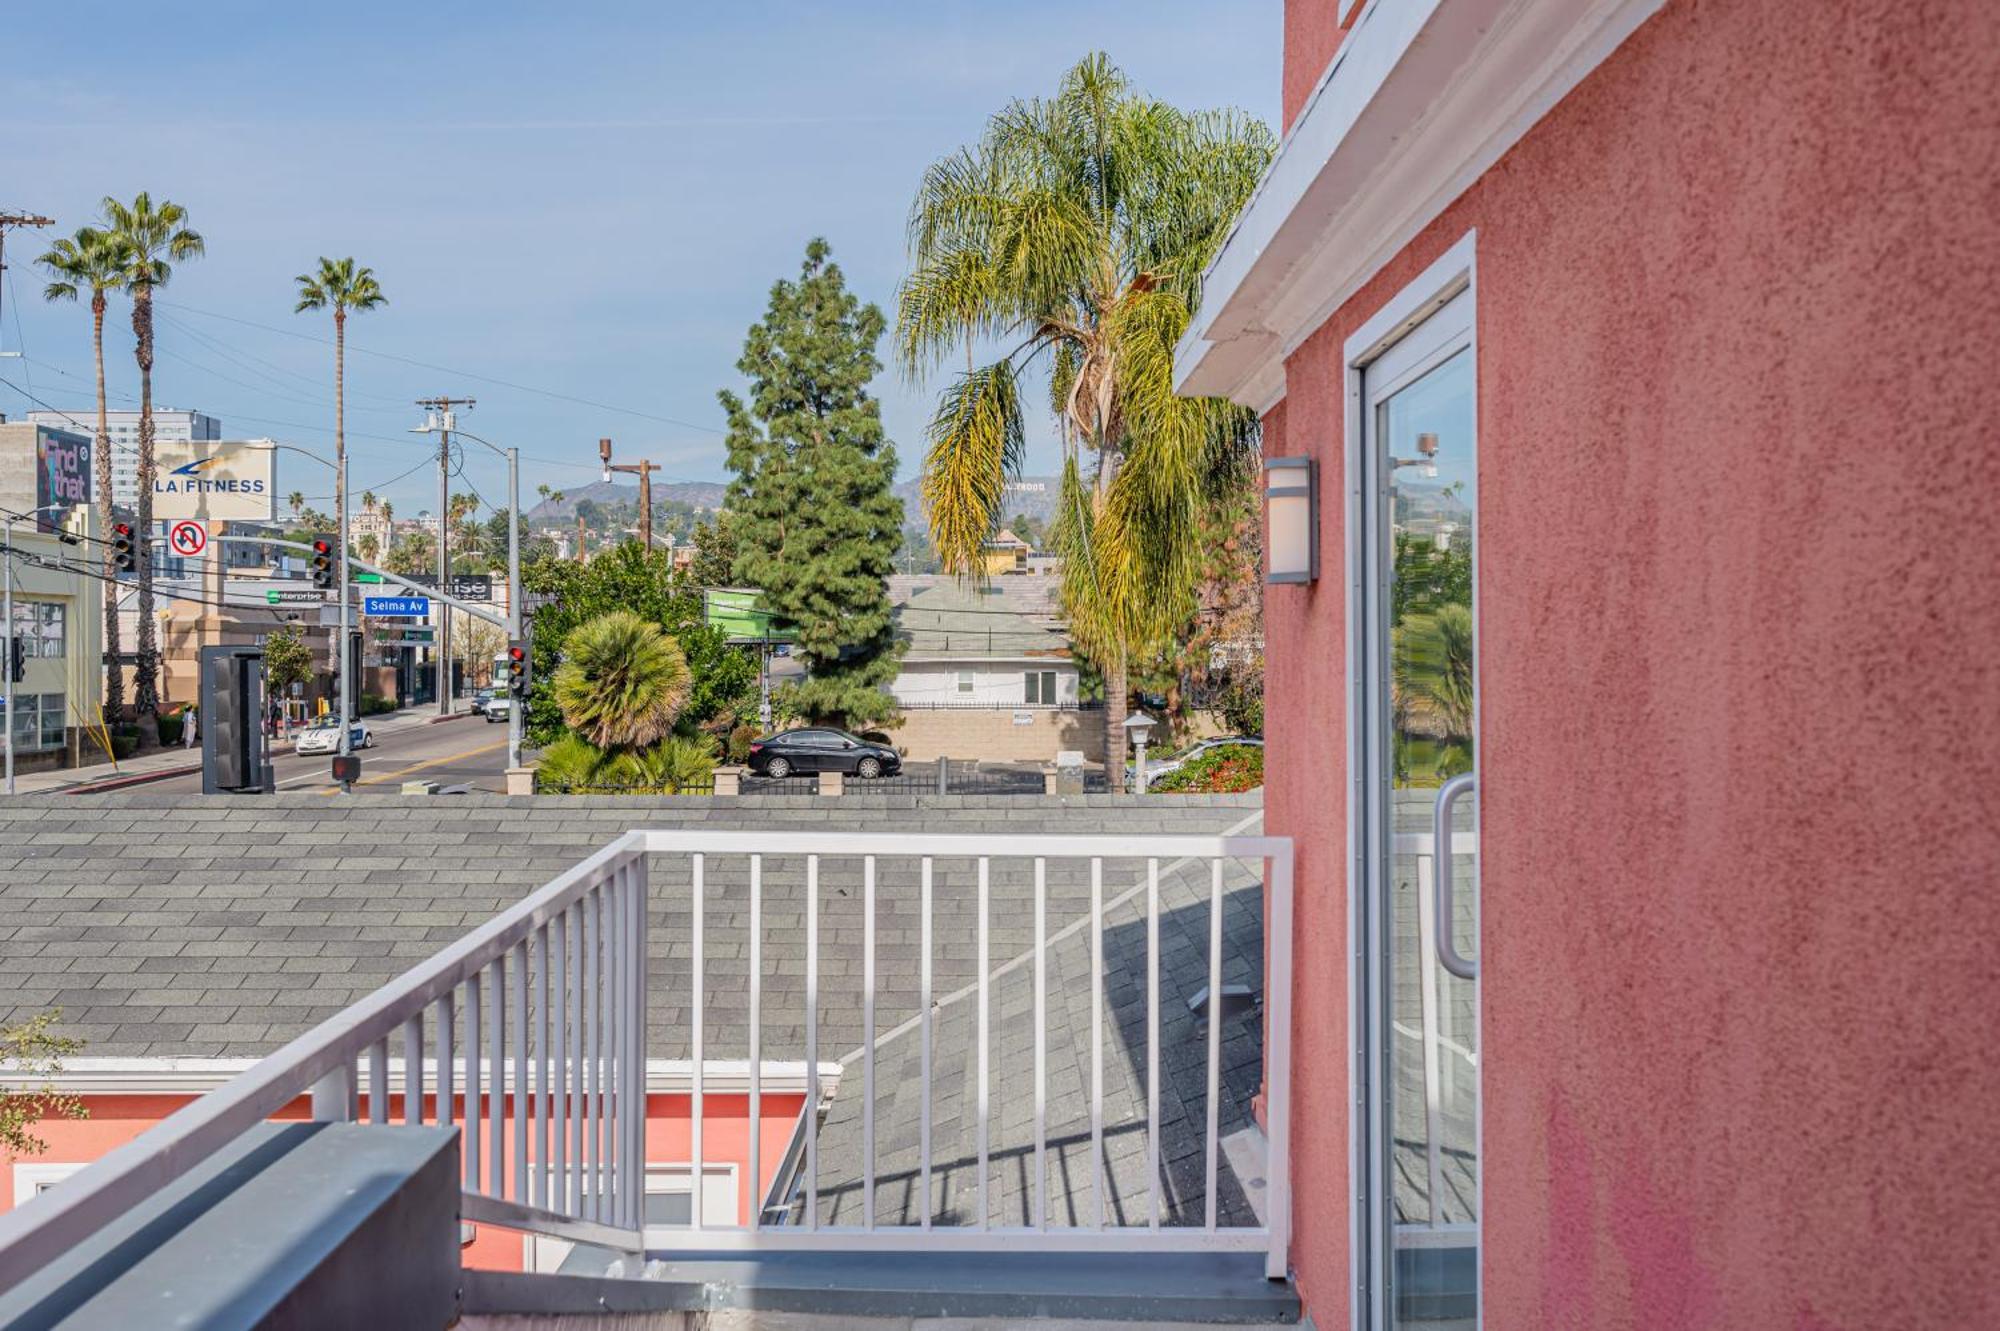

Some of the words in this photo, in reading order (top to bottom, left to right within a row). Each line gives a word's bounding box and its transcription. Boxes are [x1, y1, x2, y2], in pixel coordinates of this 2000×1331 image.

[55, 470, 85, 501] that
[155, 479, 178, 493] LA
[186, 479, 265, 493] FITNESS
[371, 600, 405, 611] Selma
[410, 600, 423, 611] Av
